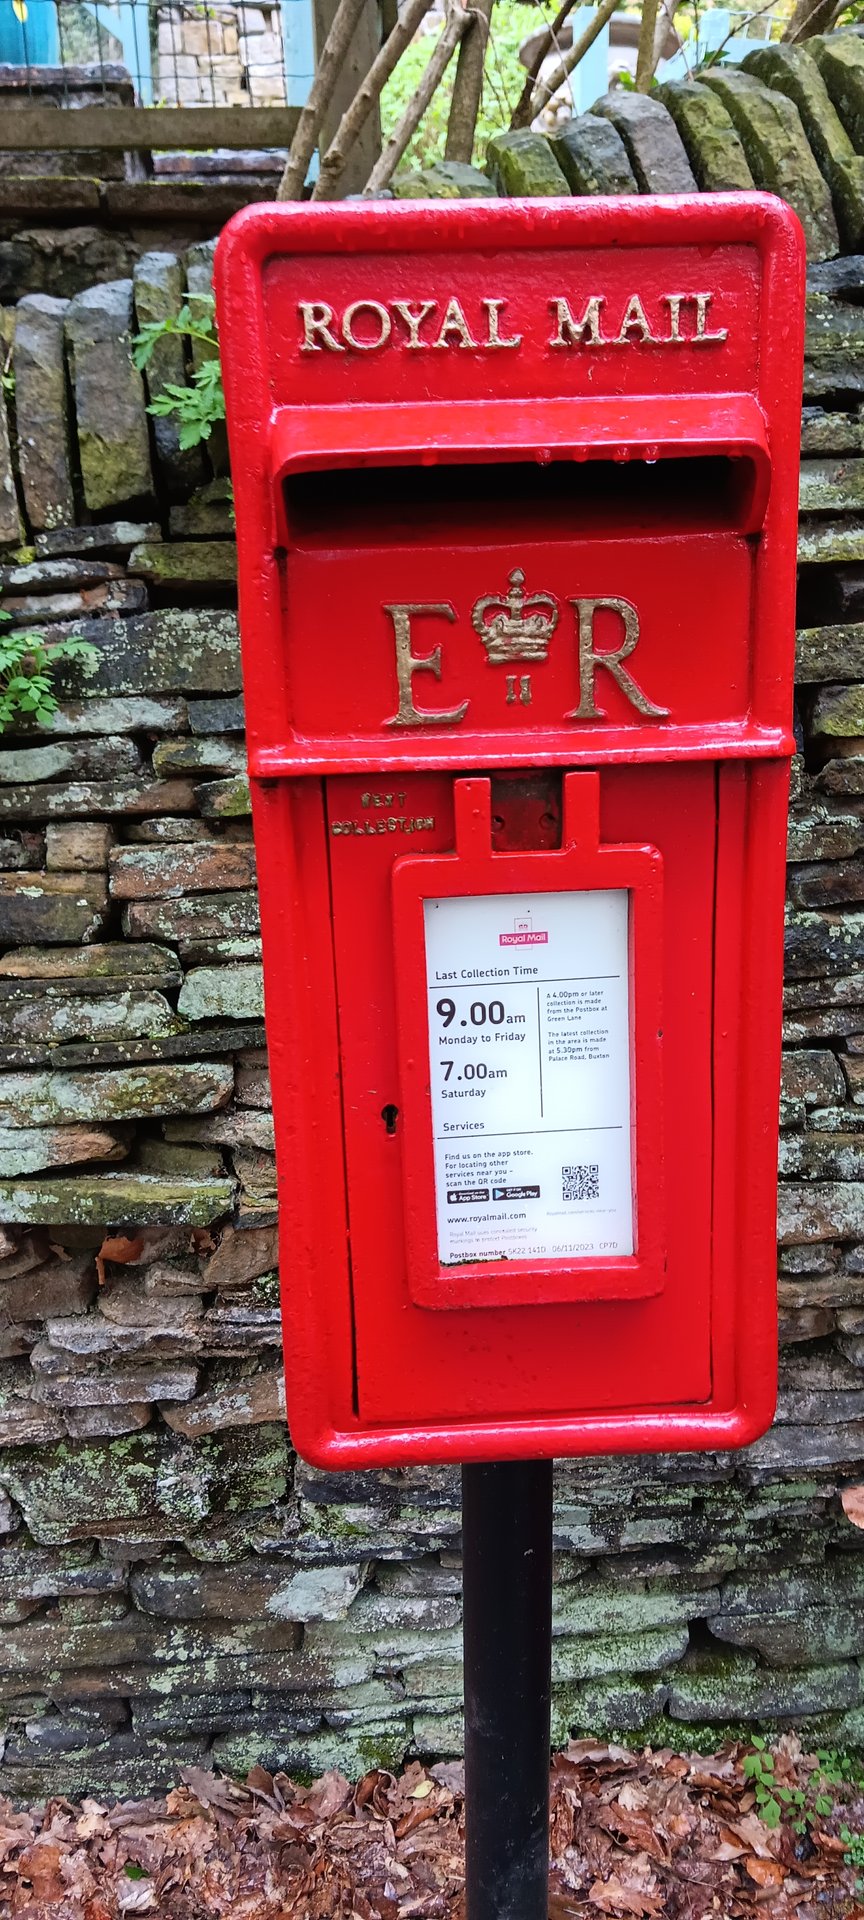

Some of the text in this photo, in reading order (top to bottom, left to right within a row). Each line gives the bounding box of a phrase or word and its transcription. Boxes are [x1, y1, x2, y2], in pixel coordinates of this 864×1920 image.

[298, 292, 729, 351] ROYAL MAIL
[382, 595, 671, 727] E R
[506, 675, 531, 705] II
[361, 792, 406, 808] NEXT
[332, 817, 434, 835] COLLECTION
[501, 933, 546, 944] Royal Mail
[435, 966, 538, 980] Last Collection Time
[552, 991, 579, 999] 4.00pm
[436, 998, 526, 1027] 9.00am
[439, 1035, 478, 1045] Monday
[495, 1032, 526, 1042] Friday
[556, 1046, 583, 1054] 5.30pm
[440, 1061, 507, 1081] 7.00am
[441, 1088, 486, 1098] Saturday
[443, 1121, 485, 1131] Services
[458, 1161, 487, 1169] locating
[506, 1190, 538, 1199] Google Play
[447, 1212, 526, 1224] www.royalmail.com
[449, 1251, 477, 1259] Postbox
[552, 1243, 594, 1252] 06/11/2023
